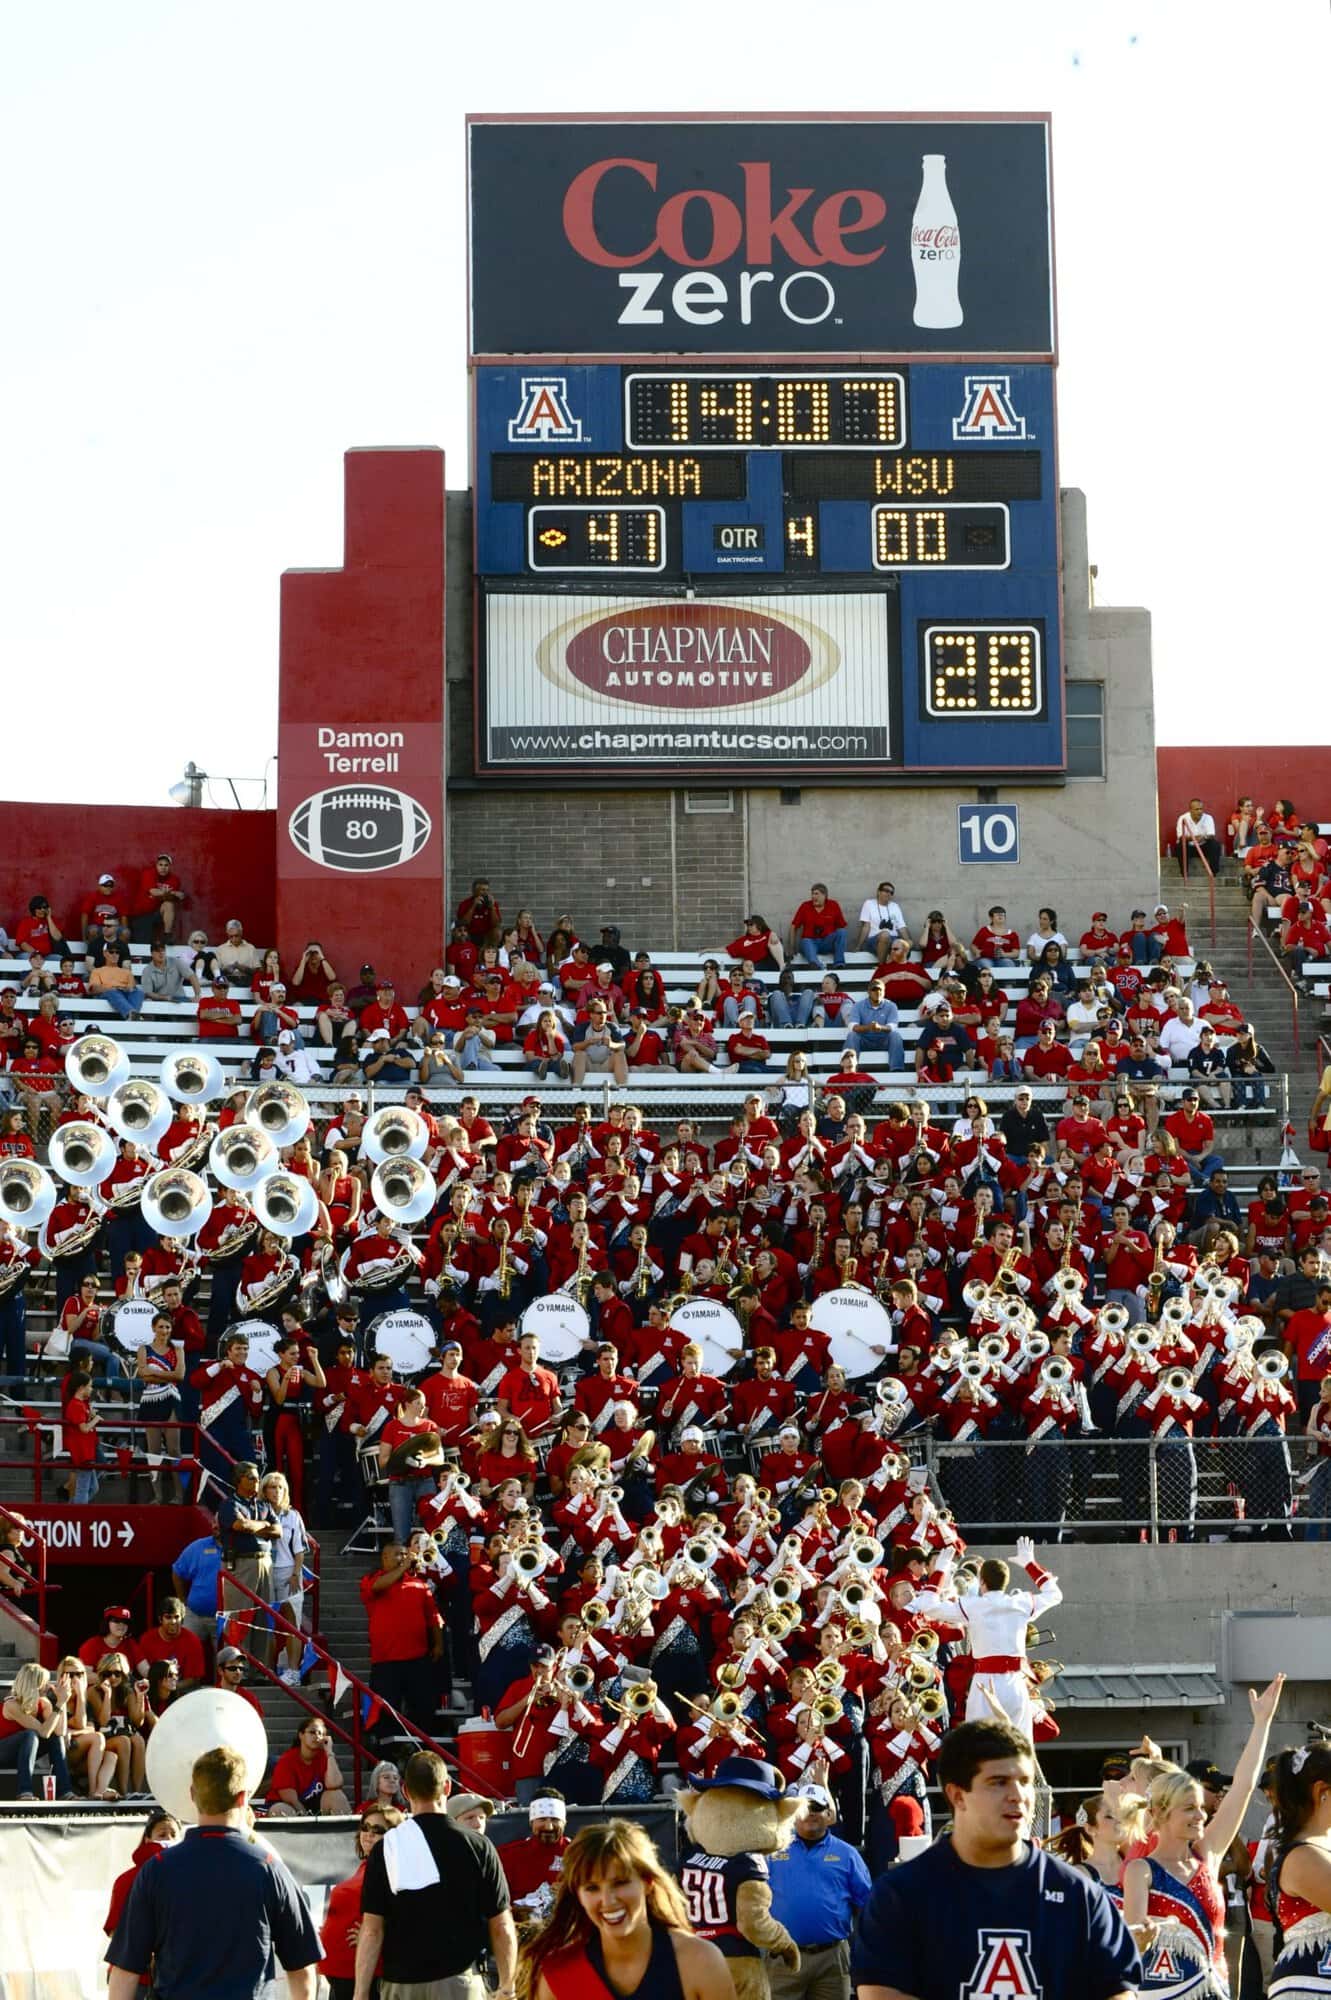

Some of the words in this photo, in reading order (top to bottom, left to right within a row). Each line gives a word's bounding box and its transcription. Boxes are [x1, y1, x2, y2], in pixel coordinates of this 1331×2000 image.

[562, 157, 887, 268] Coke
[920, 249, 955, 261] zero
[617, 271, 835, 325] zero
[671, 382, 895, 441] 14:07
[532, 459, 702, 496] ARIZONA
[875, 457, 955, 496] WSU
[588, 512, 656, 562] 41
[720, 527, 758, 549] QTR
[787, 516, 814, 557] 4
[878, 512, 946, 561] 00
[602, 625, 774, 665] CHAPMAN
[606, 671, 774, 687] AUTOMOTIVE
[934, 635, 1031, 707] 28
[318, 728, 404, 748] Damon
[510, 730, 868, 752] www.chapmantucson.com
[323, 752, 399, 773] Terrell
[346, 820, 378, 839] 80
[961, 813, 1018, 855] 10
[545, 1303, 576, 1313] YAMAHA
[691, 1309, 721, 1319] YAMAHA
[839, 1297, 869, 1308] YAMAHA
[395, 1319, 424, 1328] YAMAHA
[89, 1520, 112, 1548] 10
[682, 1867, 729, 1924] 50
[1044, 1890, 1065, 1903] MB
